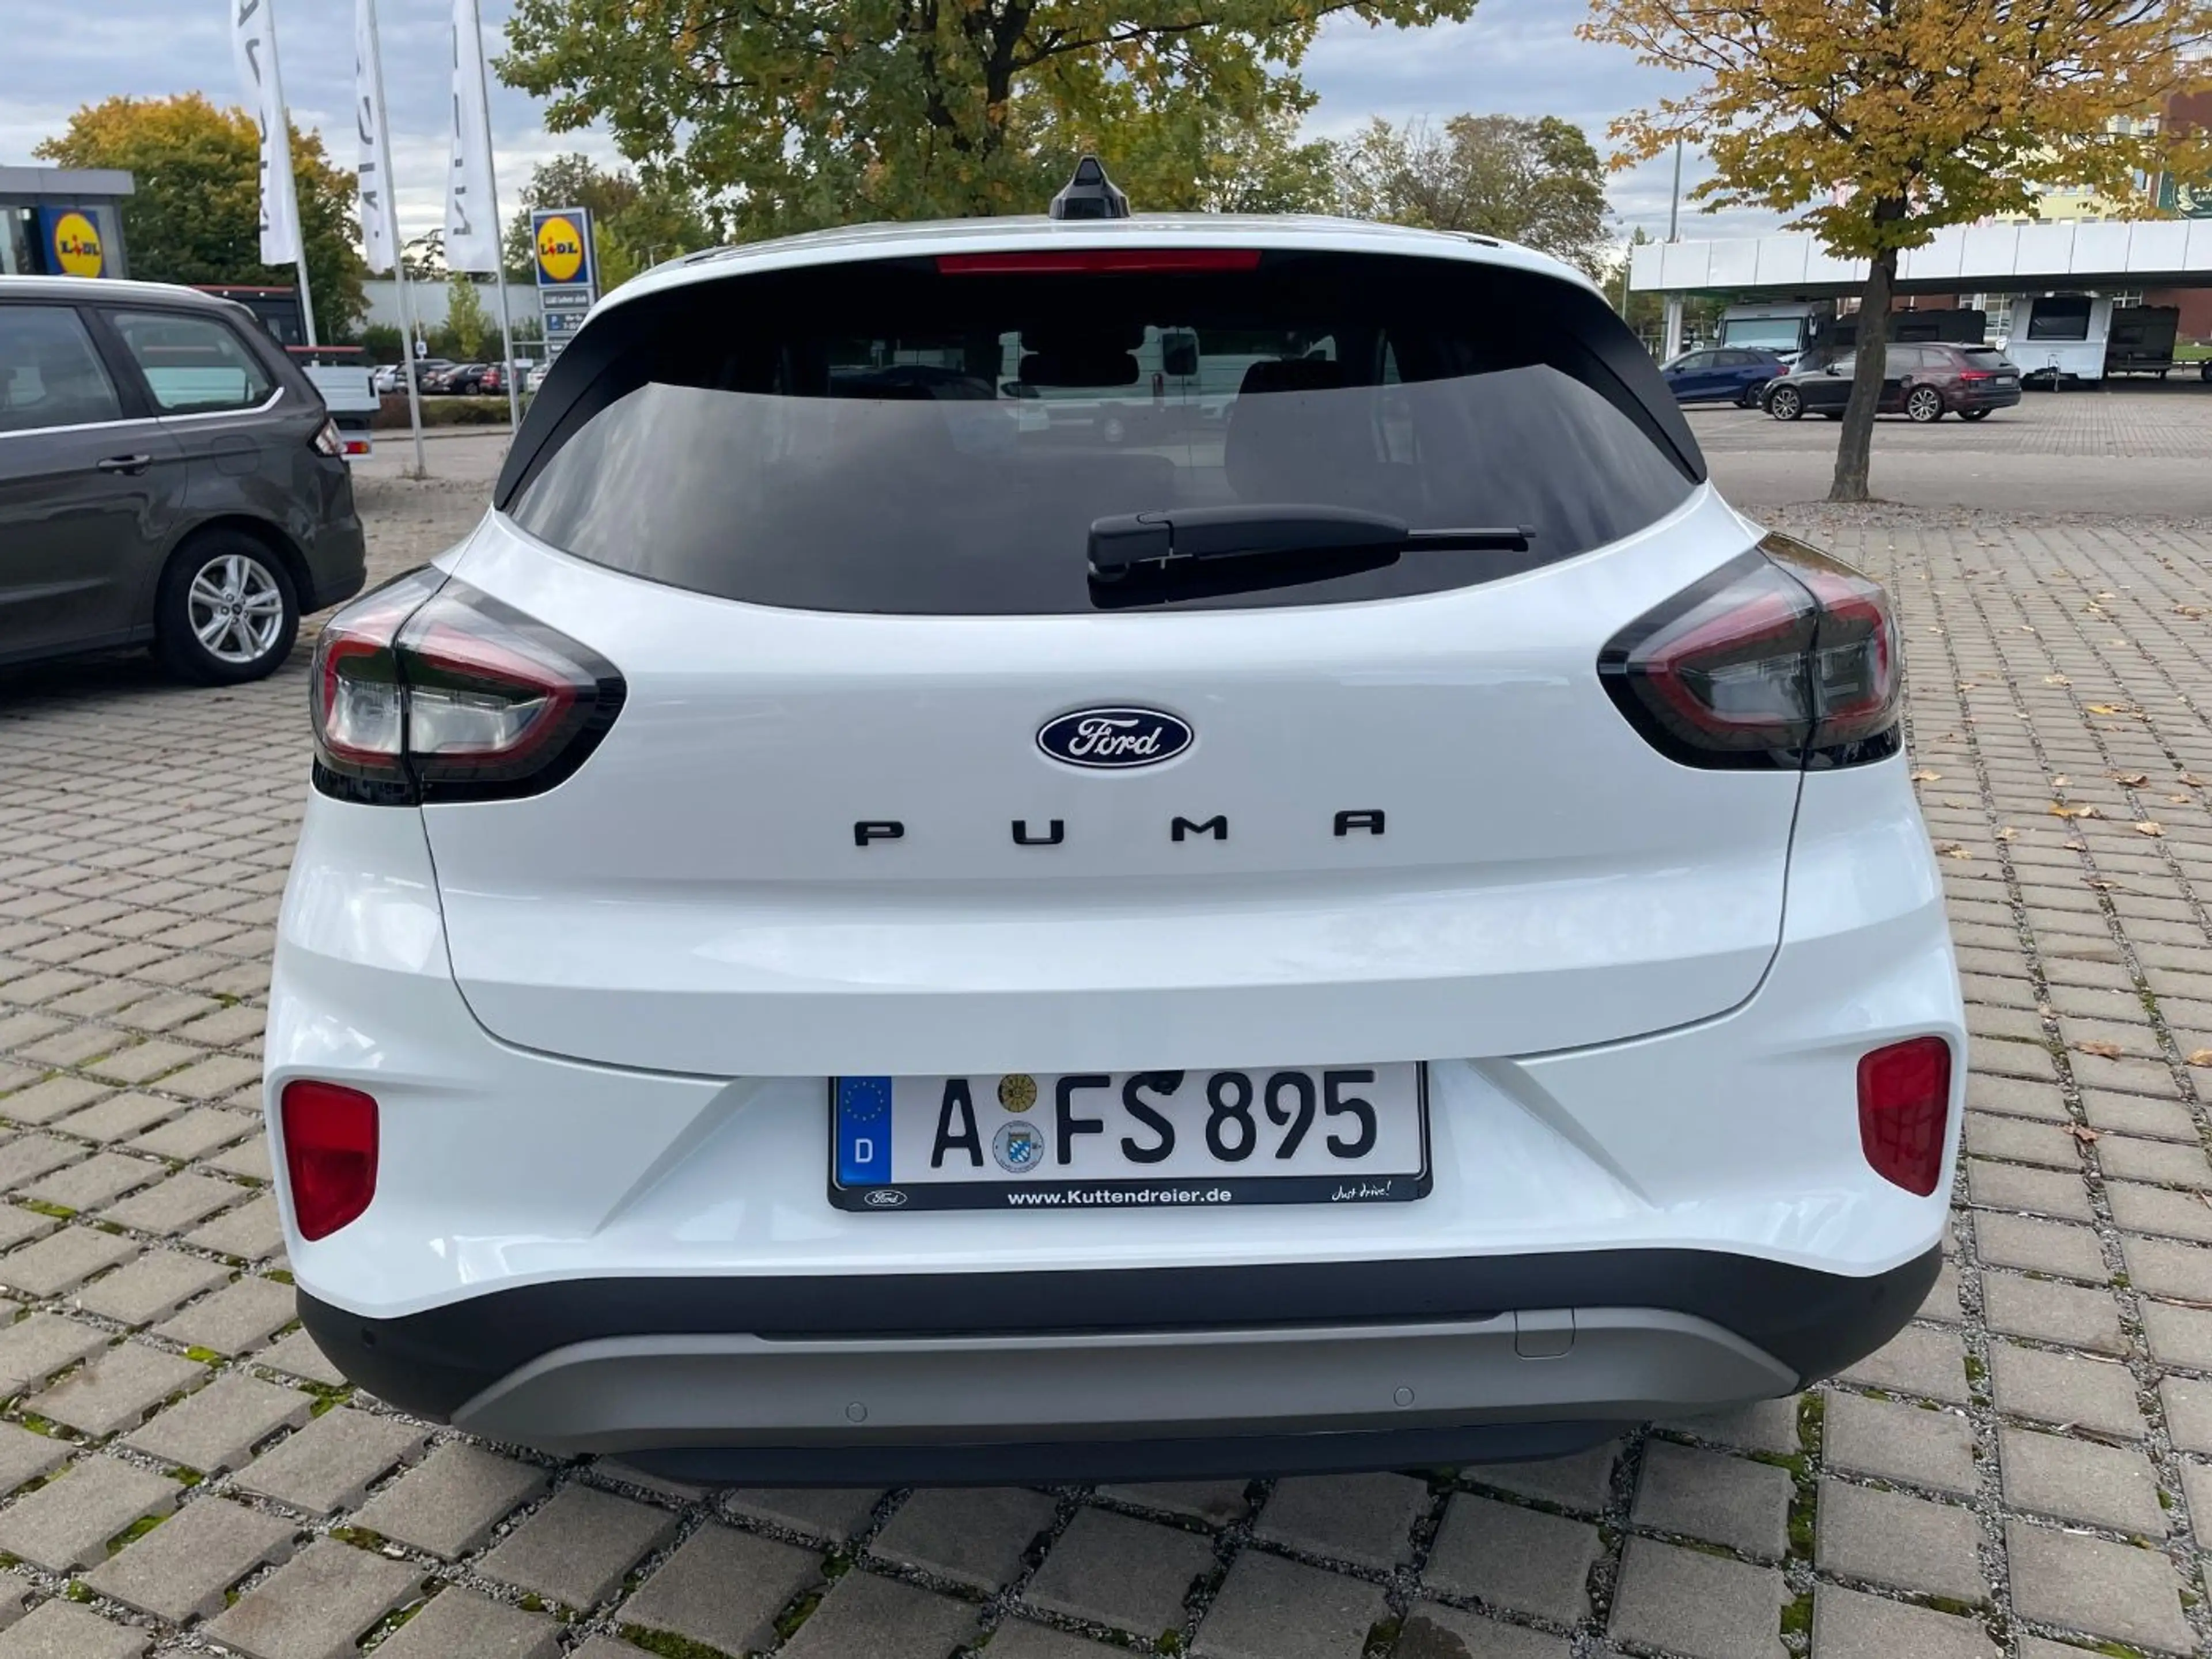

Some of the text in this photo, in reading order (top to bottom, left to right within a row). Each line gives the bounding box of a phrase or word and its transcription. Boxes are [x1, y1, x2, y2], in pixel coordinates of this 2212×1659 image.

[1069, 718, 1162, 756] Ford
[854, 809, 1385, 846] PUMA
[930, 1079, 984, 1168] A
[1055, 1071, 1176, 1165] FS
[1206, 1070, 1377, 1162] 895
[854, 1138, 873, 1163] D
[872, 1191, 898, 1203] Ford
[1007, 1188, 1232, 1205] www.Kuttendreier.de
[1331, 1180, 1392, 1201] Just drive!
